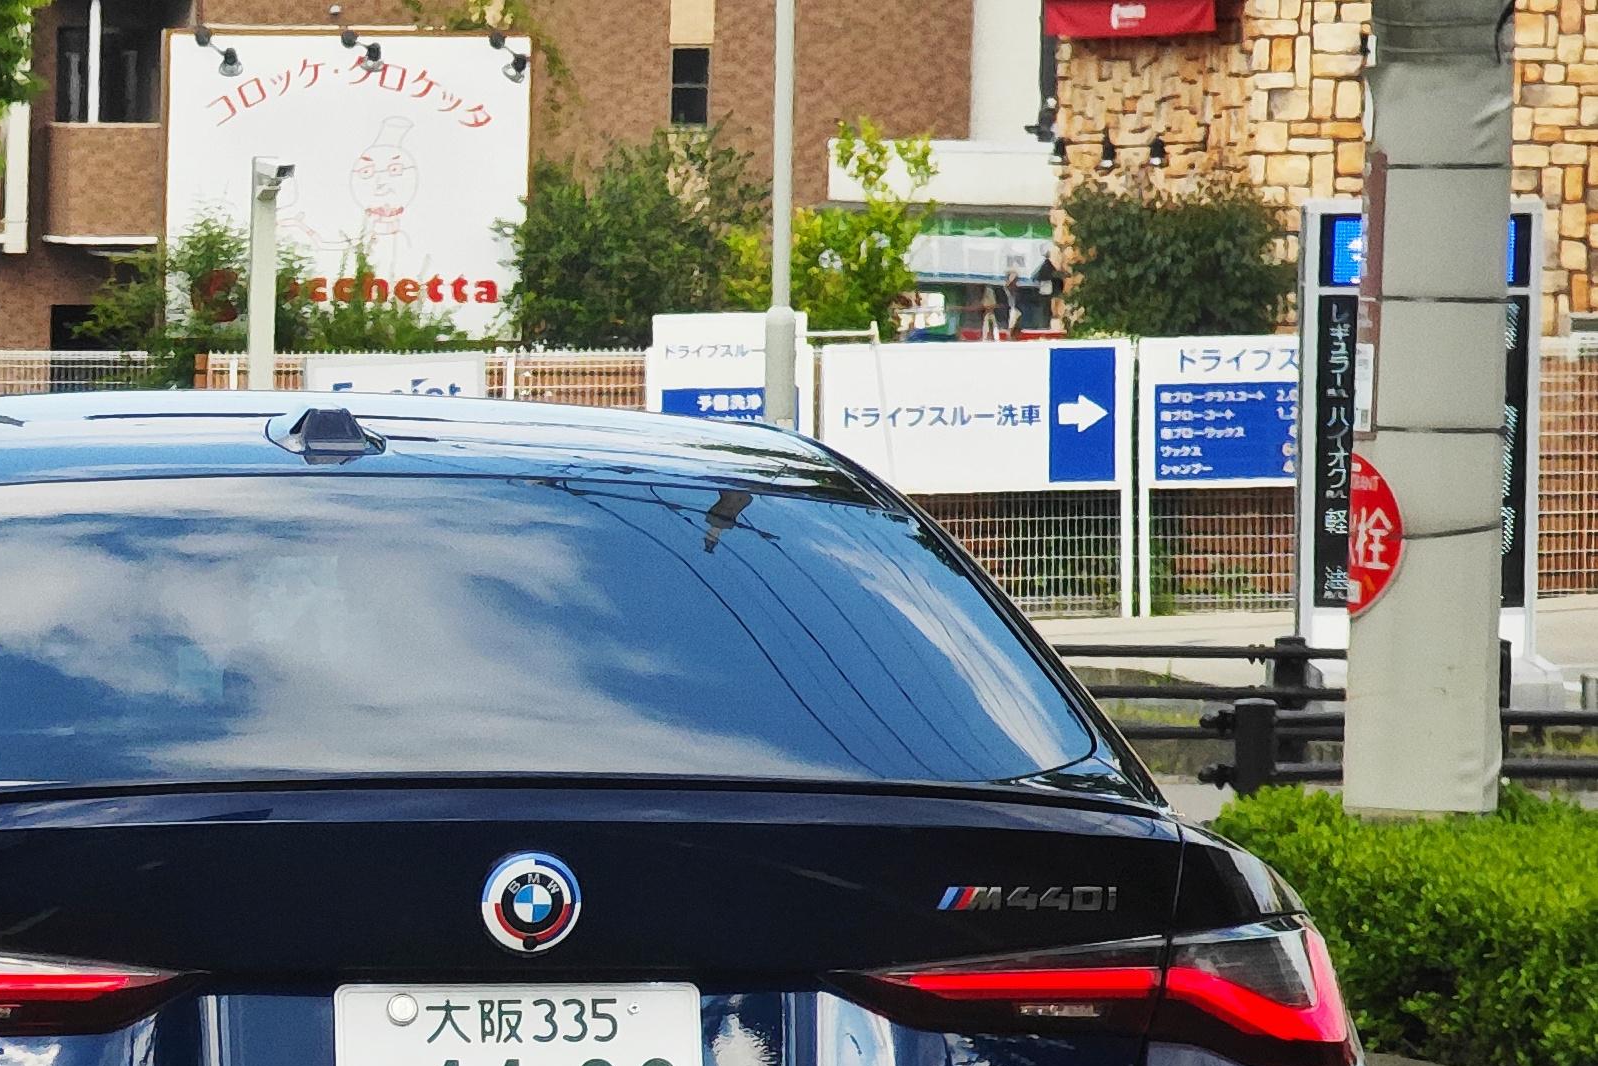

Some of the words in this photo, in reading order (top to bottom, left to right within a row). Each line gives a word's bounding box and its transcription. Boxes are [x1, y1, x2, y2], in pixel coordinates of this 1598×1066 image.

[844, 404, 1041, 428] ドライブスルー洗車
[1327, 406, 1350, 489] ハイオク
[507, 873, 560, 895] BMW
